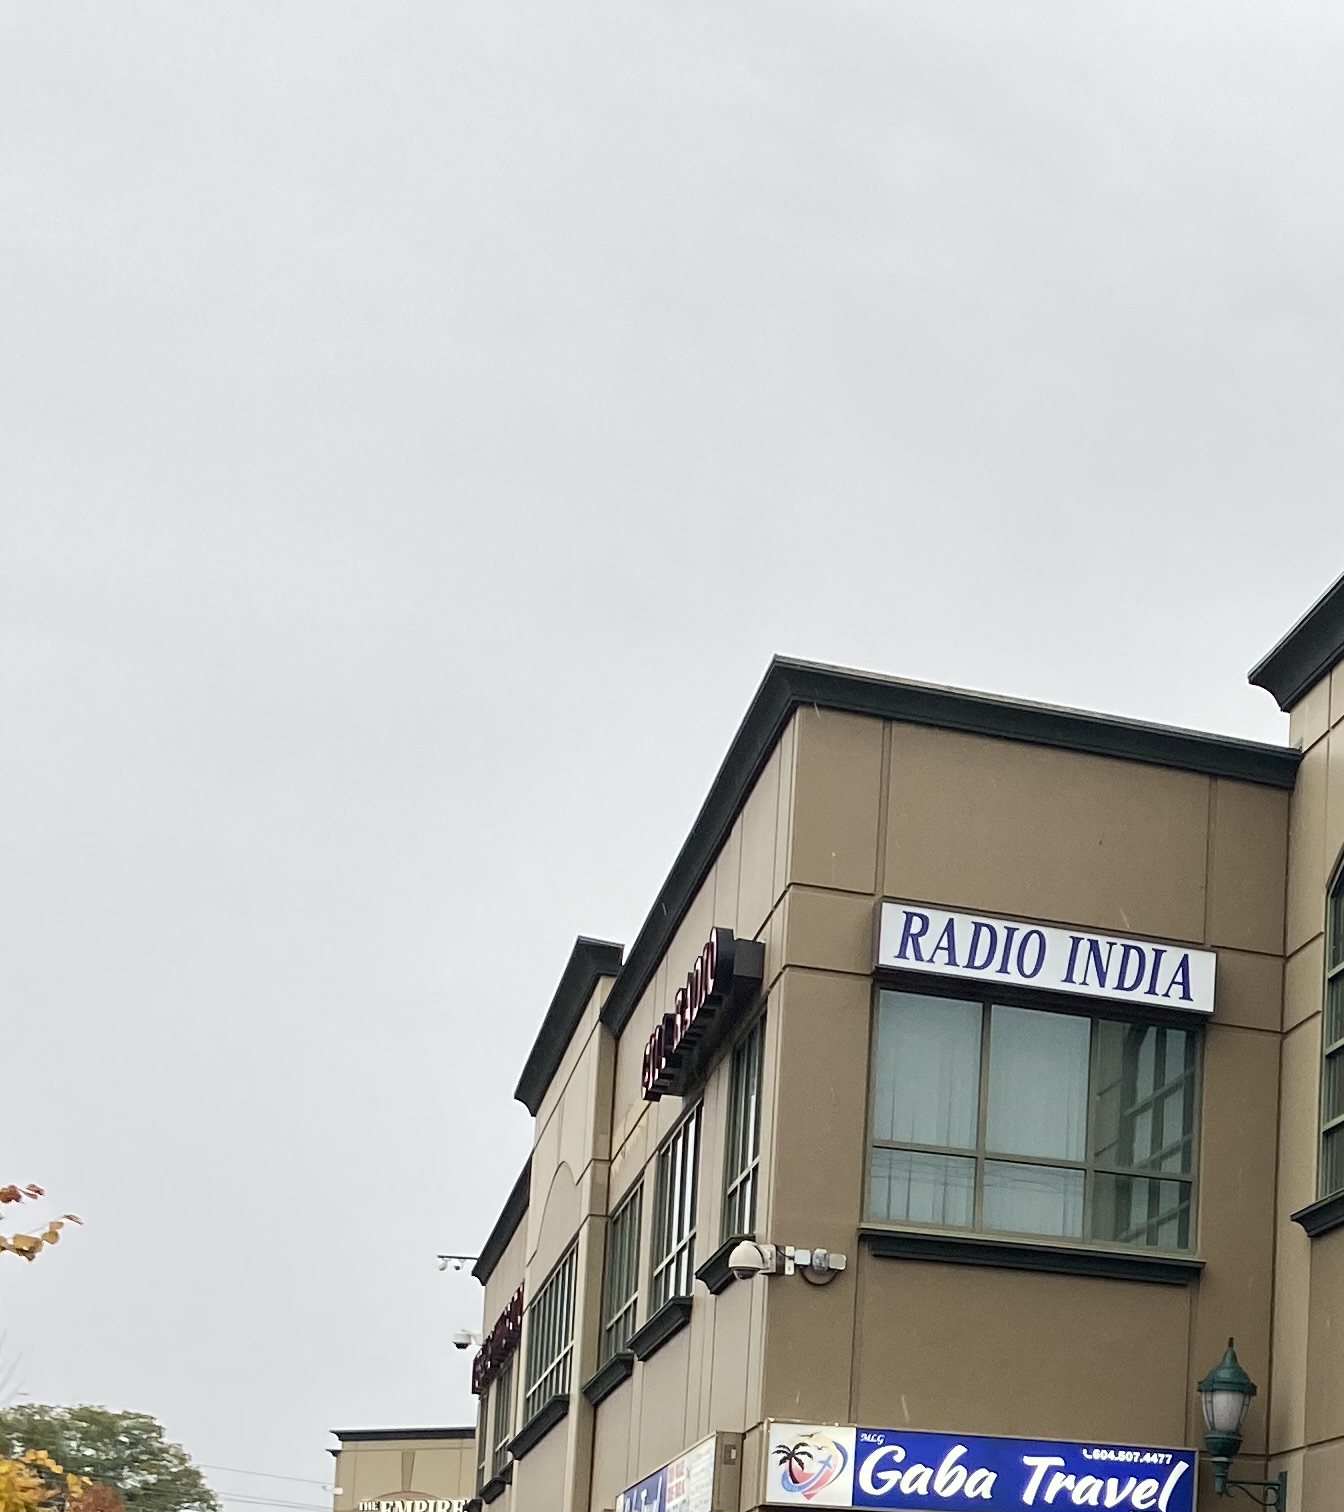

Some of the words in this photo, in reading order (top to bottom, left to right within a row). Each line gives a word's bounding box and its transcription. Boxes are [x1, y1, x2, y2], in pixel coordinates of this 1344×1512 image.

[895, 910, 1047, 979] RADIO
[1060, 935, 1194, 1002] INDIA
[860, 1432, 886, 1446] MLG
[1091, 1448, 1173, 1465] 604.507.4477
[858, 1444, 998, 1499] Gaba
[1022, 1456, 1190, 1512] Travel
[359, 1501, 379, 1511] THE
